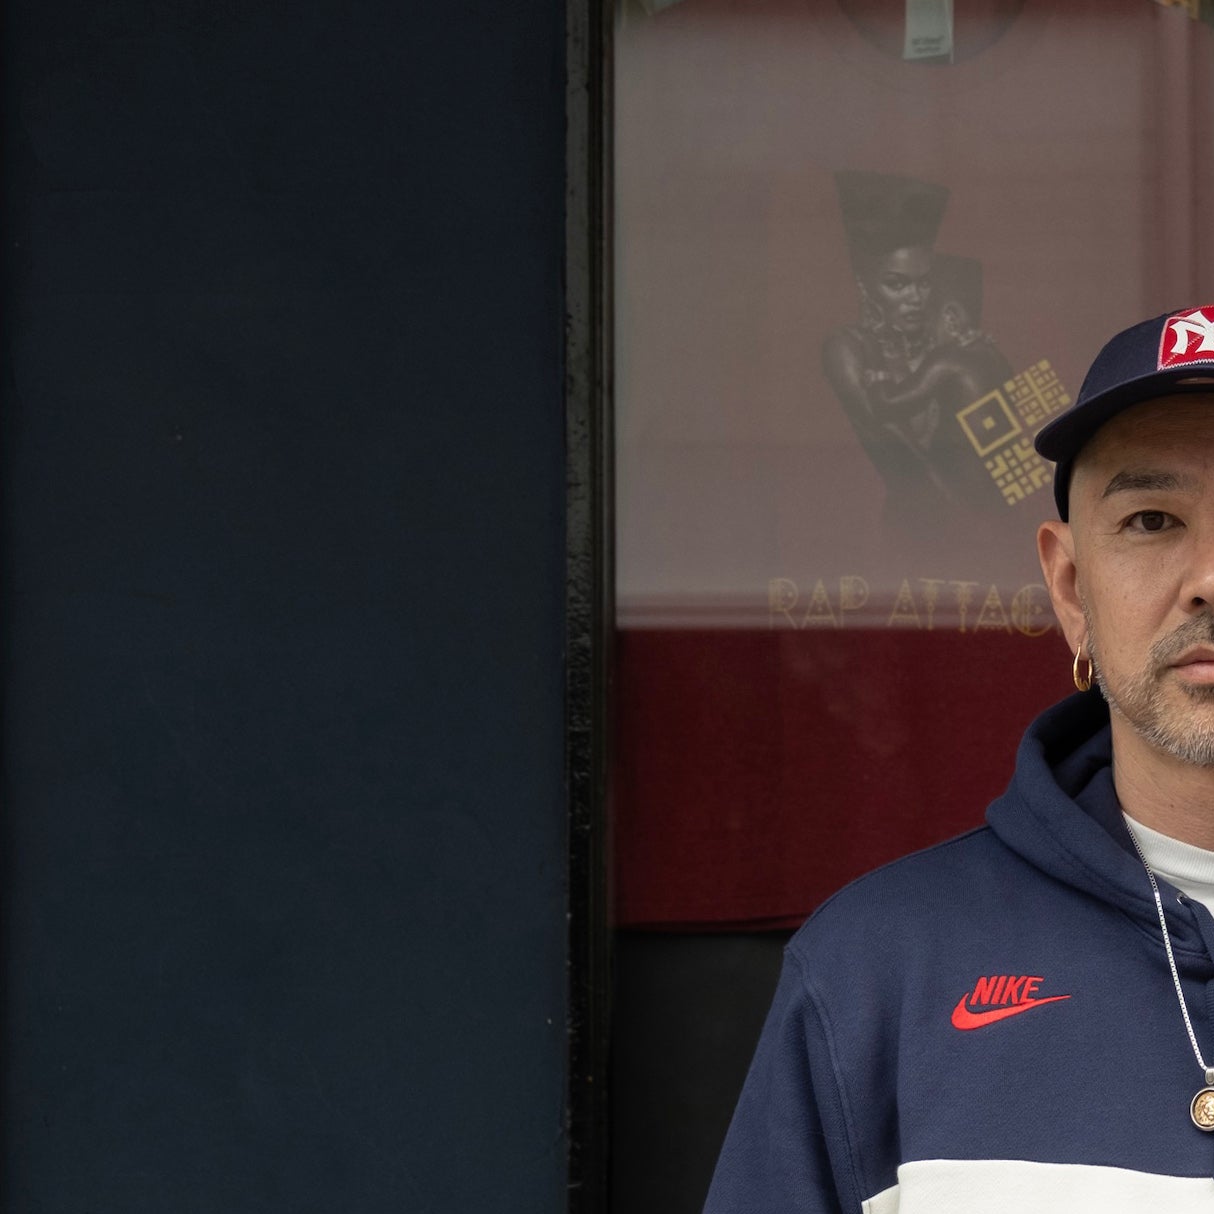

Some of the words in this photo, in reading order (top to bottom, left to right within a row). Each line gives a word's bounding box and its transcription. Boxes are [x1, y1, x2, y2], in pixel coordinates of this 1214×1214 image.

[768, 575, 870, 631] RAP
[887, 577, 1063, 638] ATTAC
[969, 975, 1045, 1006] NIKE
